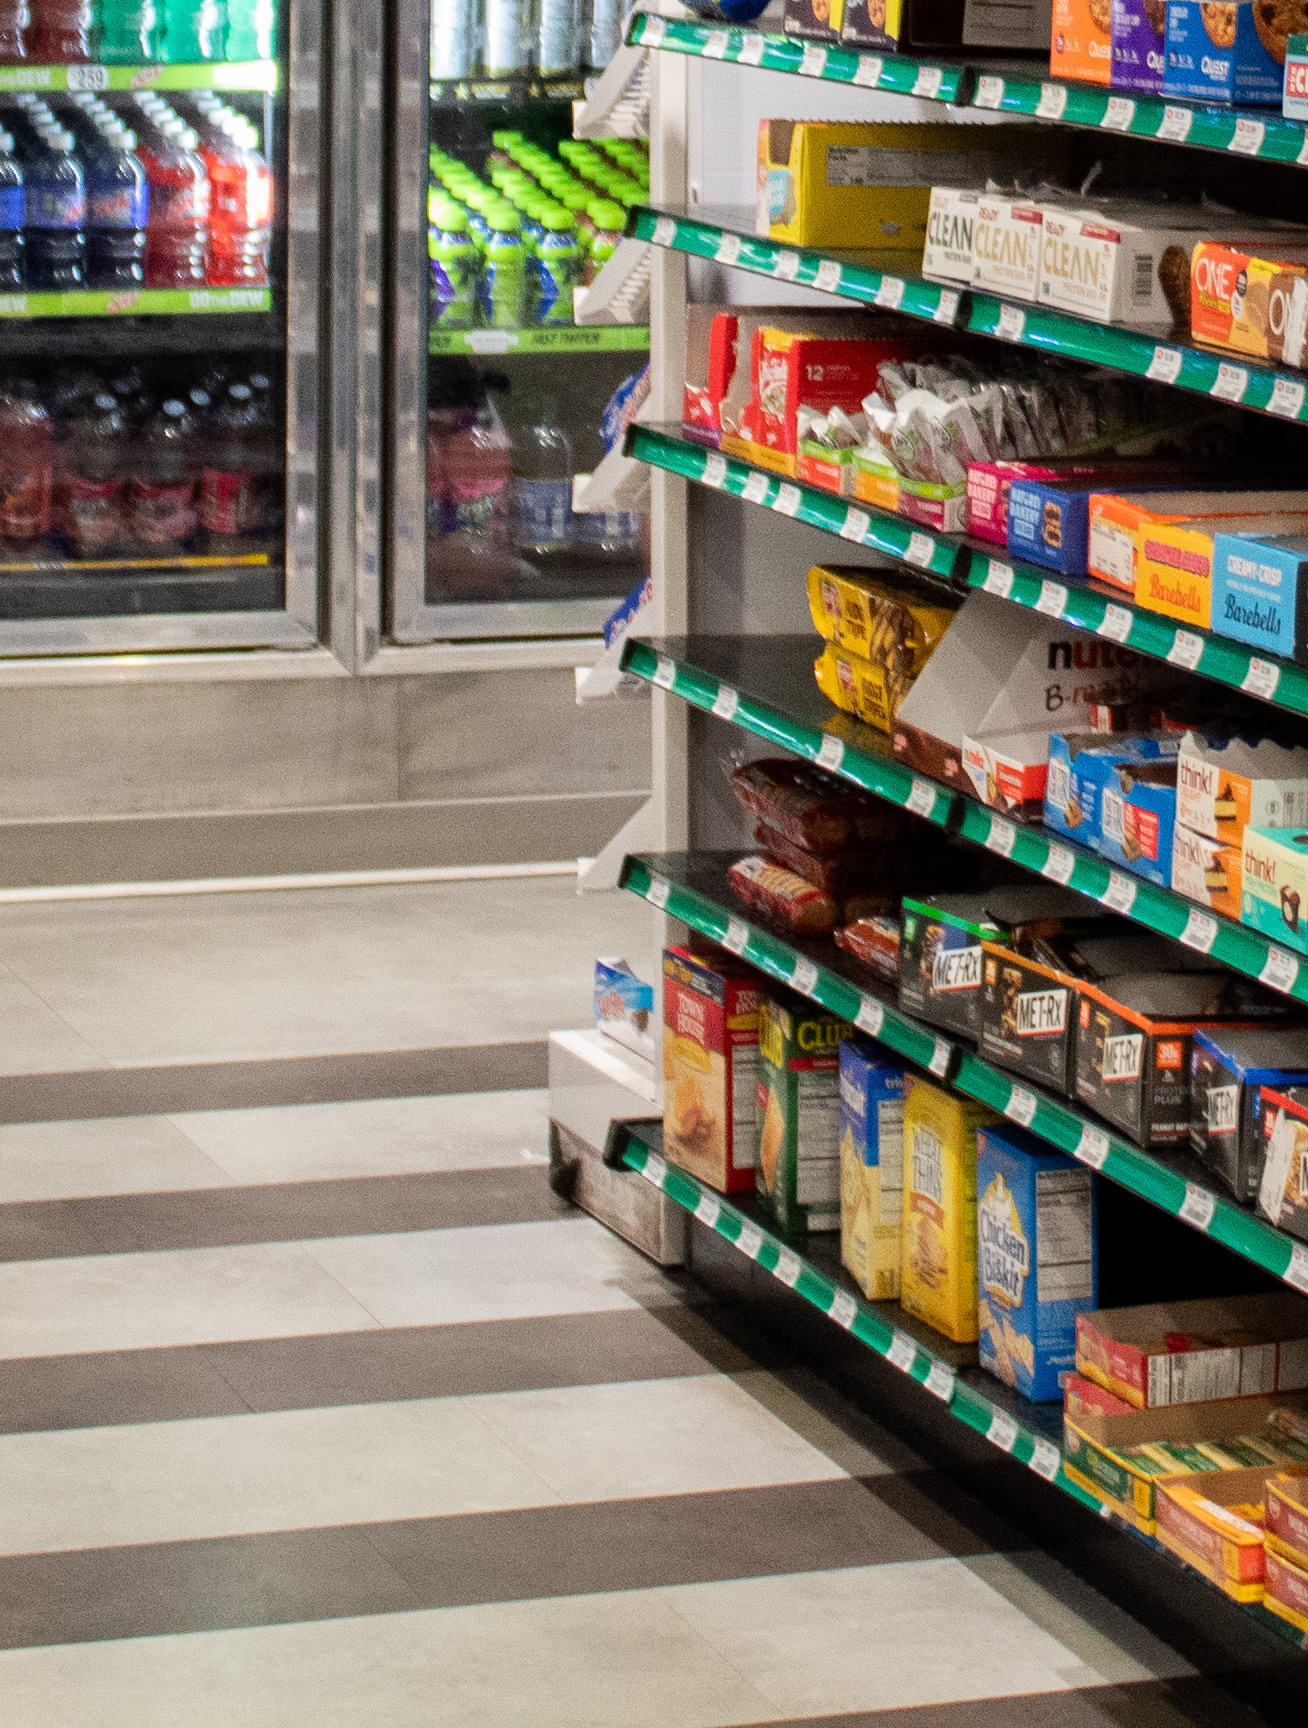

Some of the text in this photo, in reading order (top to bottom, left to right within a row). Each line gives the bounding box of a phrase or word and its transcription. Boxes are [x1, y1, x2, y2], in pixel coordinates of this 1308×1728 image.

[928, 210, 973, 247] CLEAN
[976, 221, 1028, 263] CLEAN
[1042, 235, 1101, 286] CLEAN
[1194, 256, 1233, 300] ONE
[1224, 594, 1282, 636] Barebells
[1180, 761, 1213, 796] think!
[1245, 847, 1277, 885] think!
